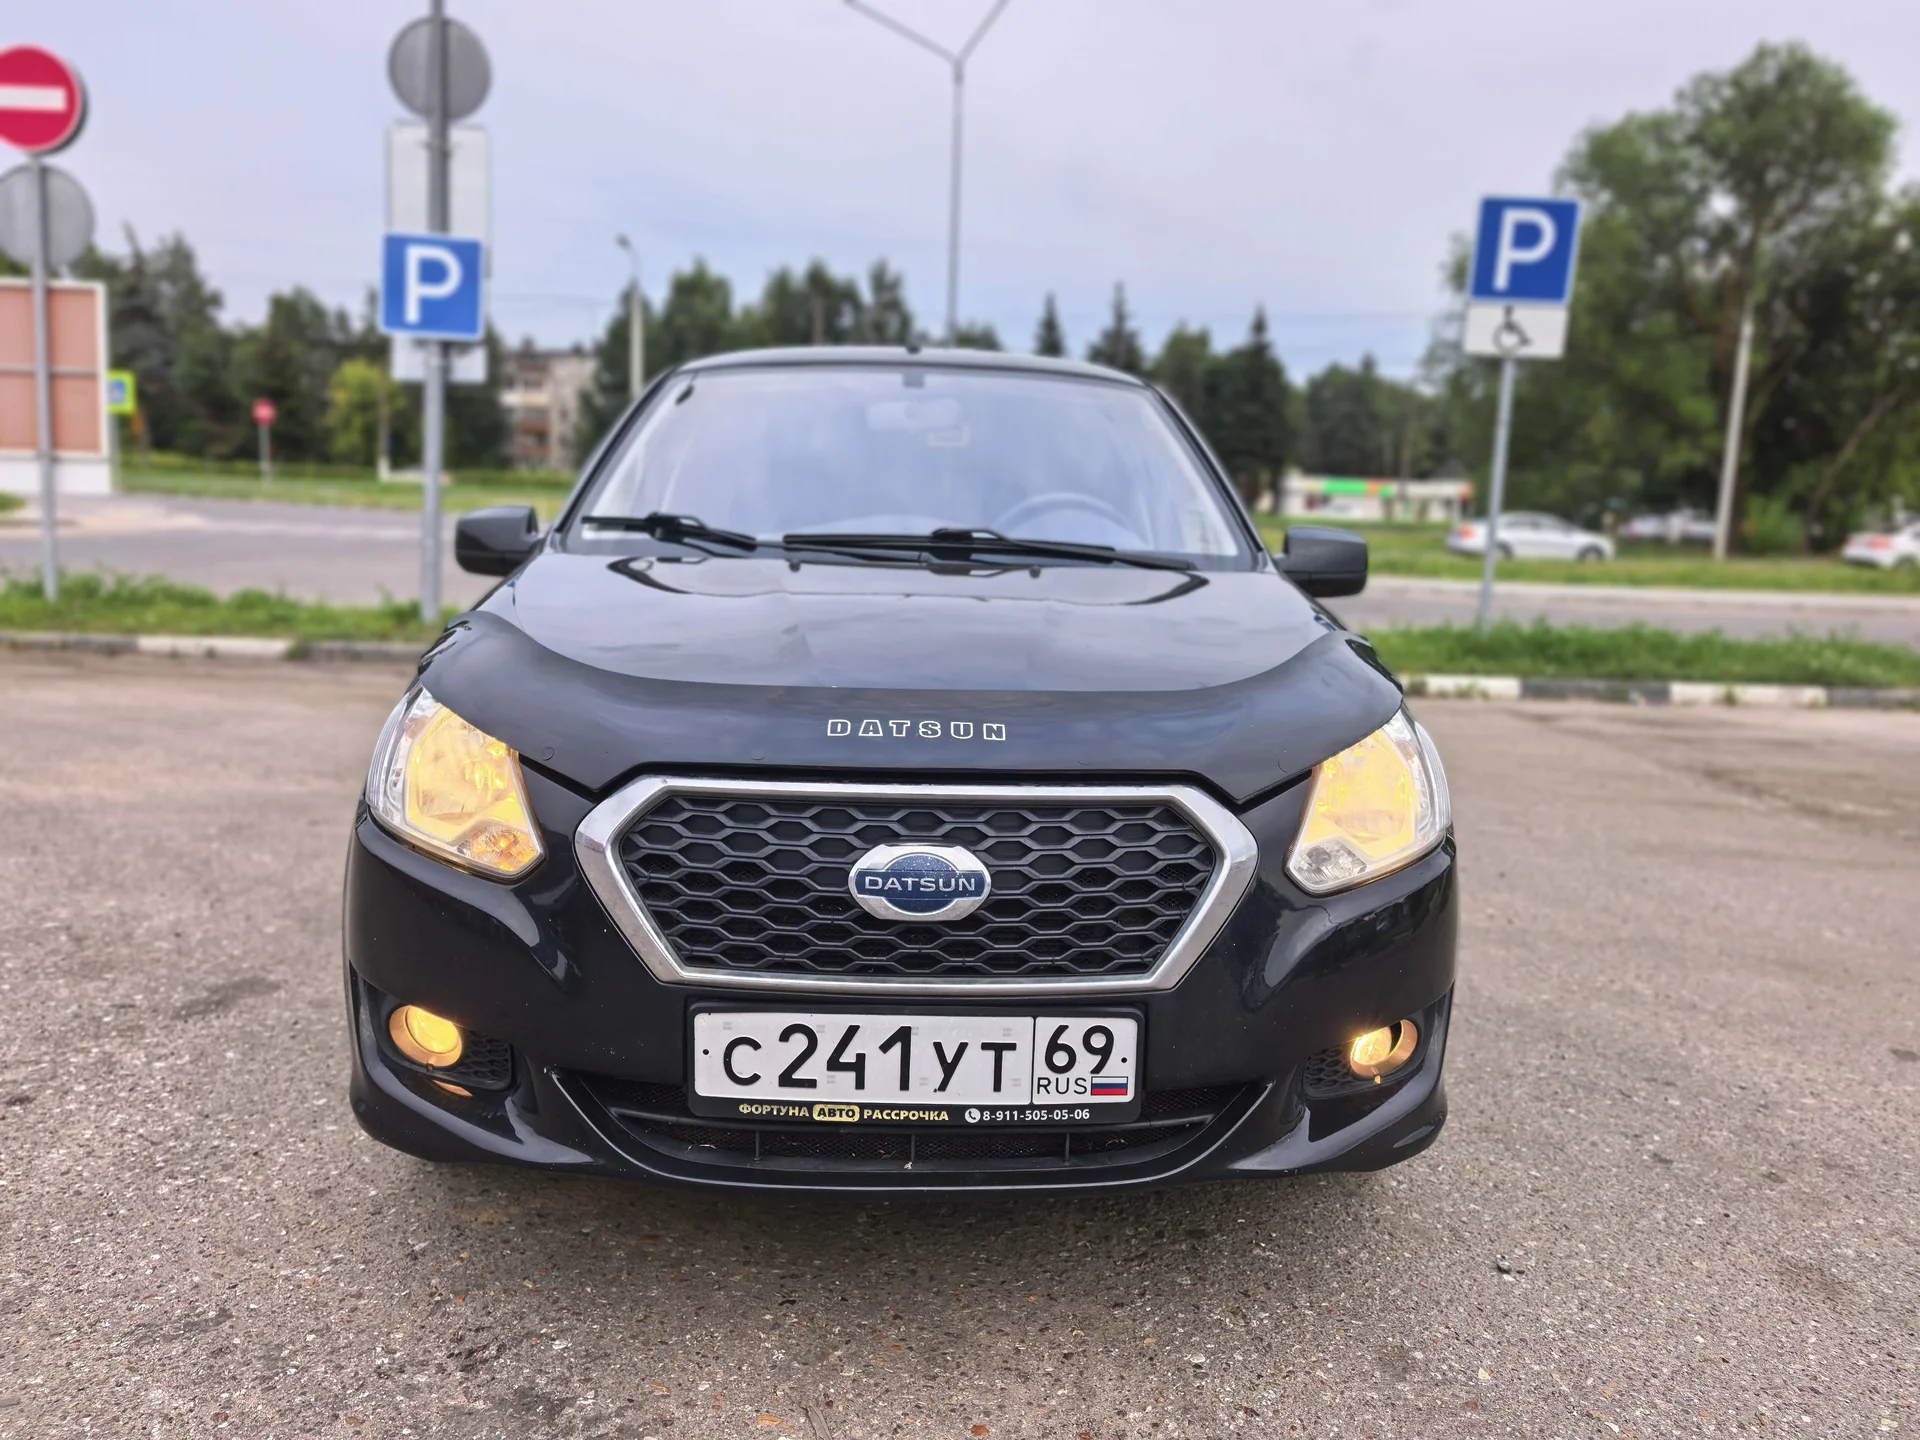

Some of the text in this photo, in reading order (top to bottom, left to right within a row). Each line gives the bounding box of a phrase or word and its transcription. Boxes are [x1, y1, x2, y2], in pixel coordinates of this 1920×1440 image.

[1493, 207, 1556, 291] P
[404, 244, 463, 324] P
[827, 719, 1006, 741] DATSUN
[864, 876, 975, 892] DATSUN
[1044, 1024, 1115, 1075] 69
[1036, 1076, 1088, 1095] RUS
[738, 1103, 949, 1121] ФОРТУНА АВТО РАССРОЧКА
[982, 1108, 1091, 1121] 8-911-505-05-06
